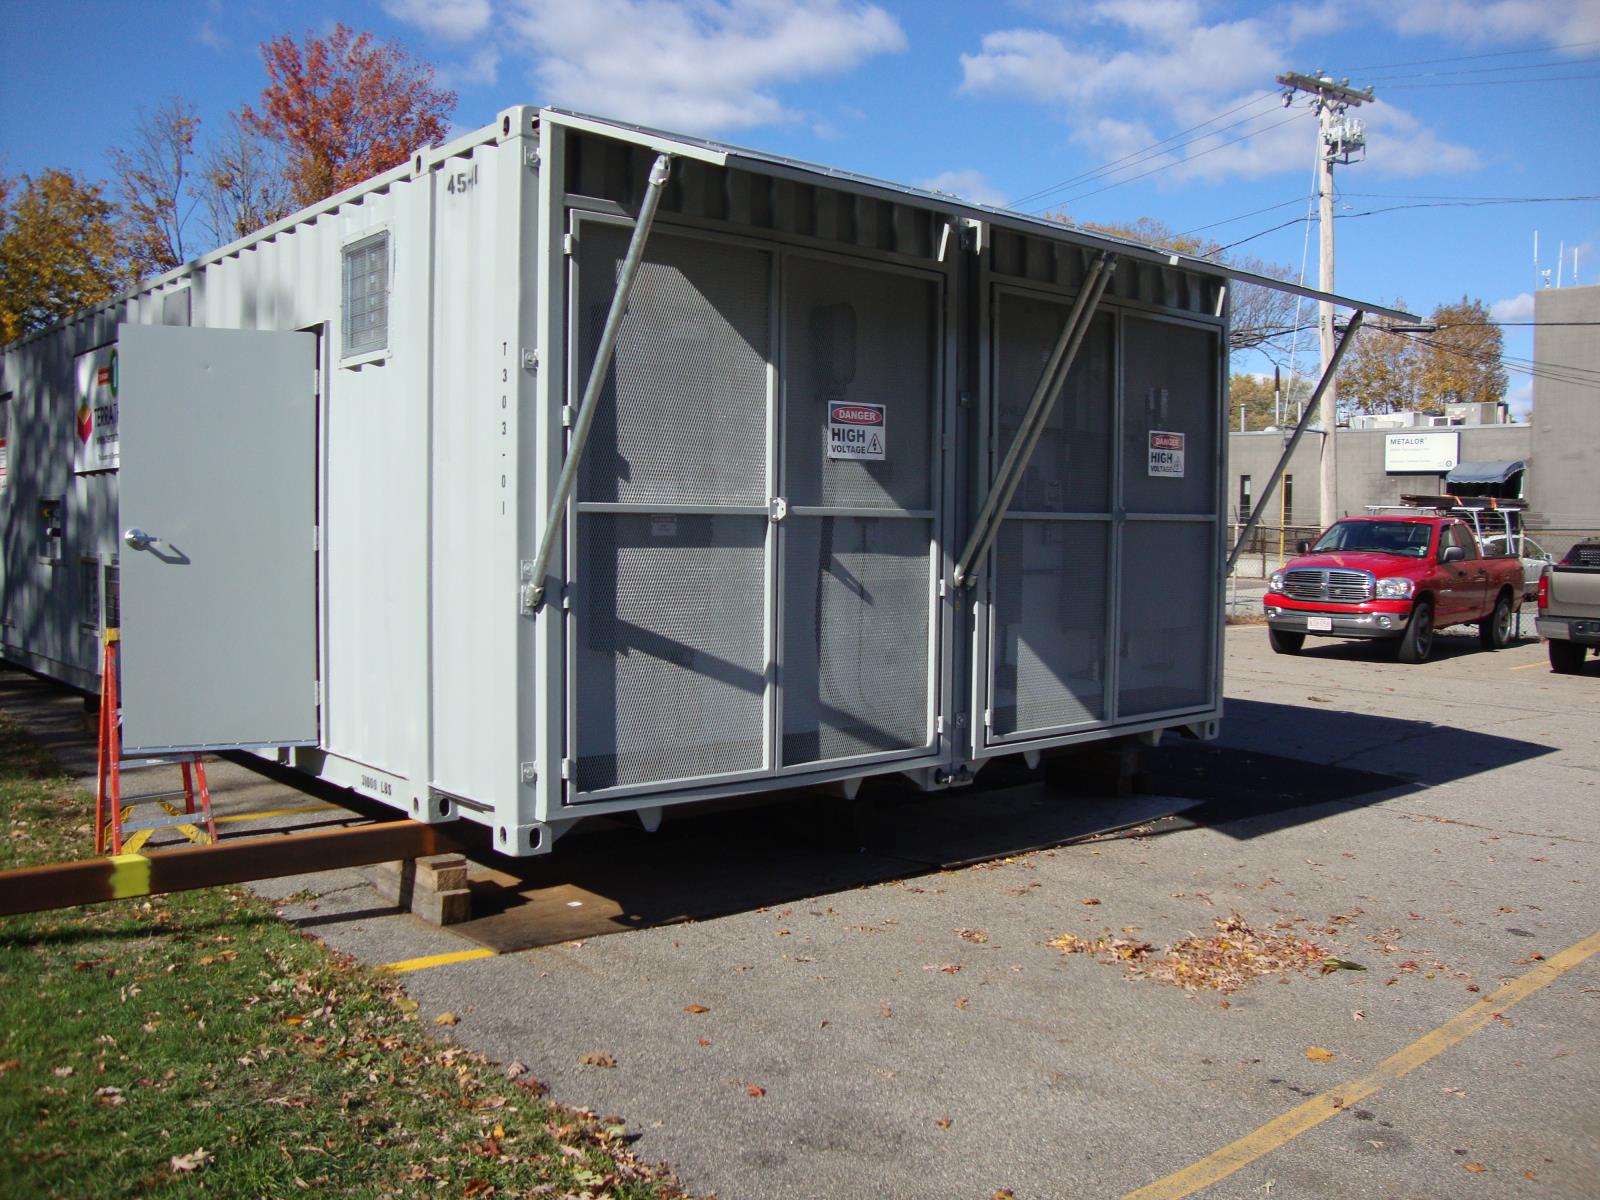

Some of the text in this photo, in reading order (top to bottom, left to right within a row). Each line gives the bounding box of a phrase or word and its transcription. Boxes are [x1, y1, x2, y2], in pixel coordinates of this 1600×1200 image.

[94, 403, 120, 427] TERRAT
[838, 409, 876, 421] DANGER
[831, 427, 866, 443] HIGH
[831, 444, 866, 454] VOLTAGE
[1151, 452, 1173, 464] HIGH
[380, 780, 392, 796] LBS
